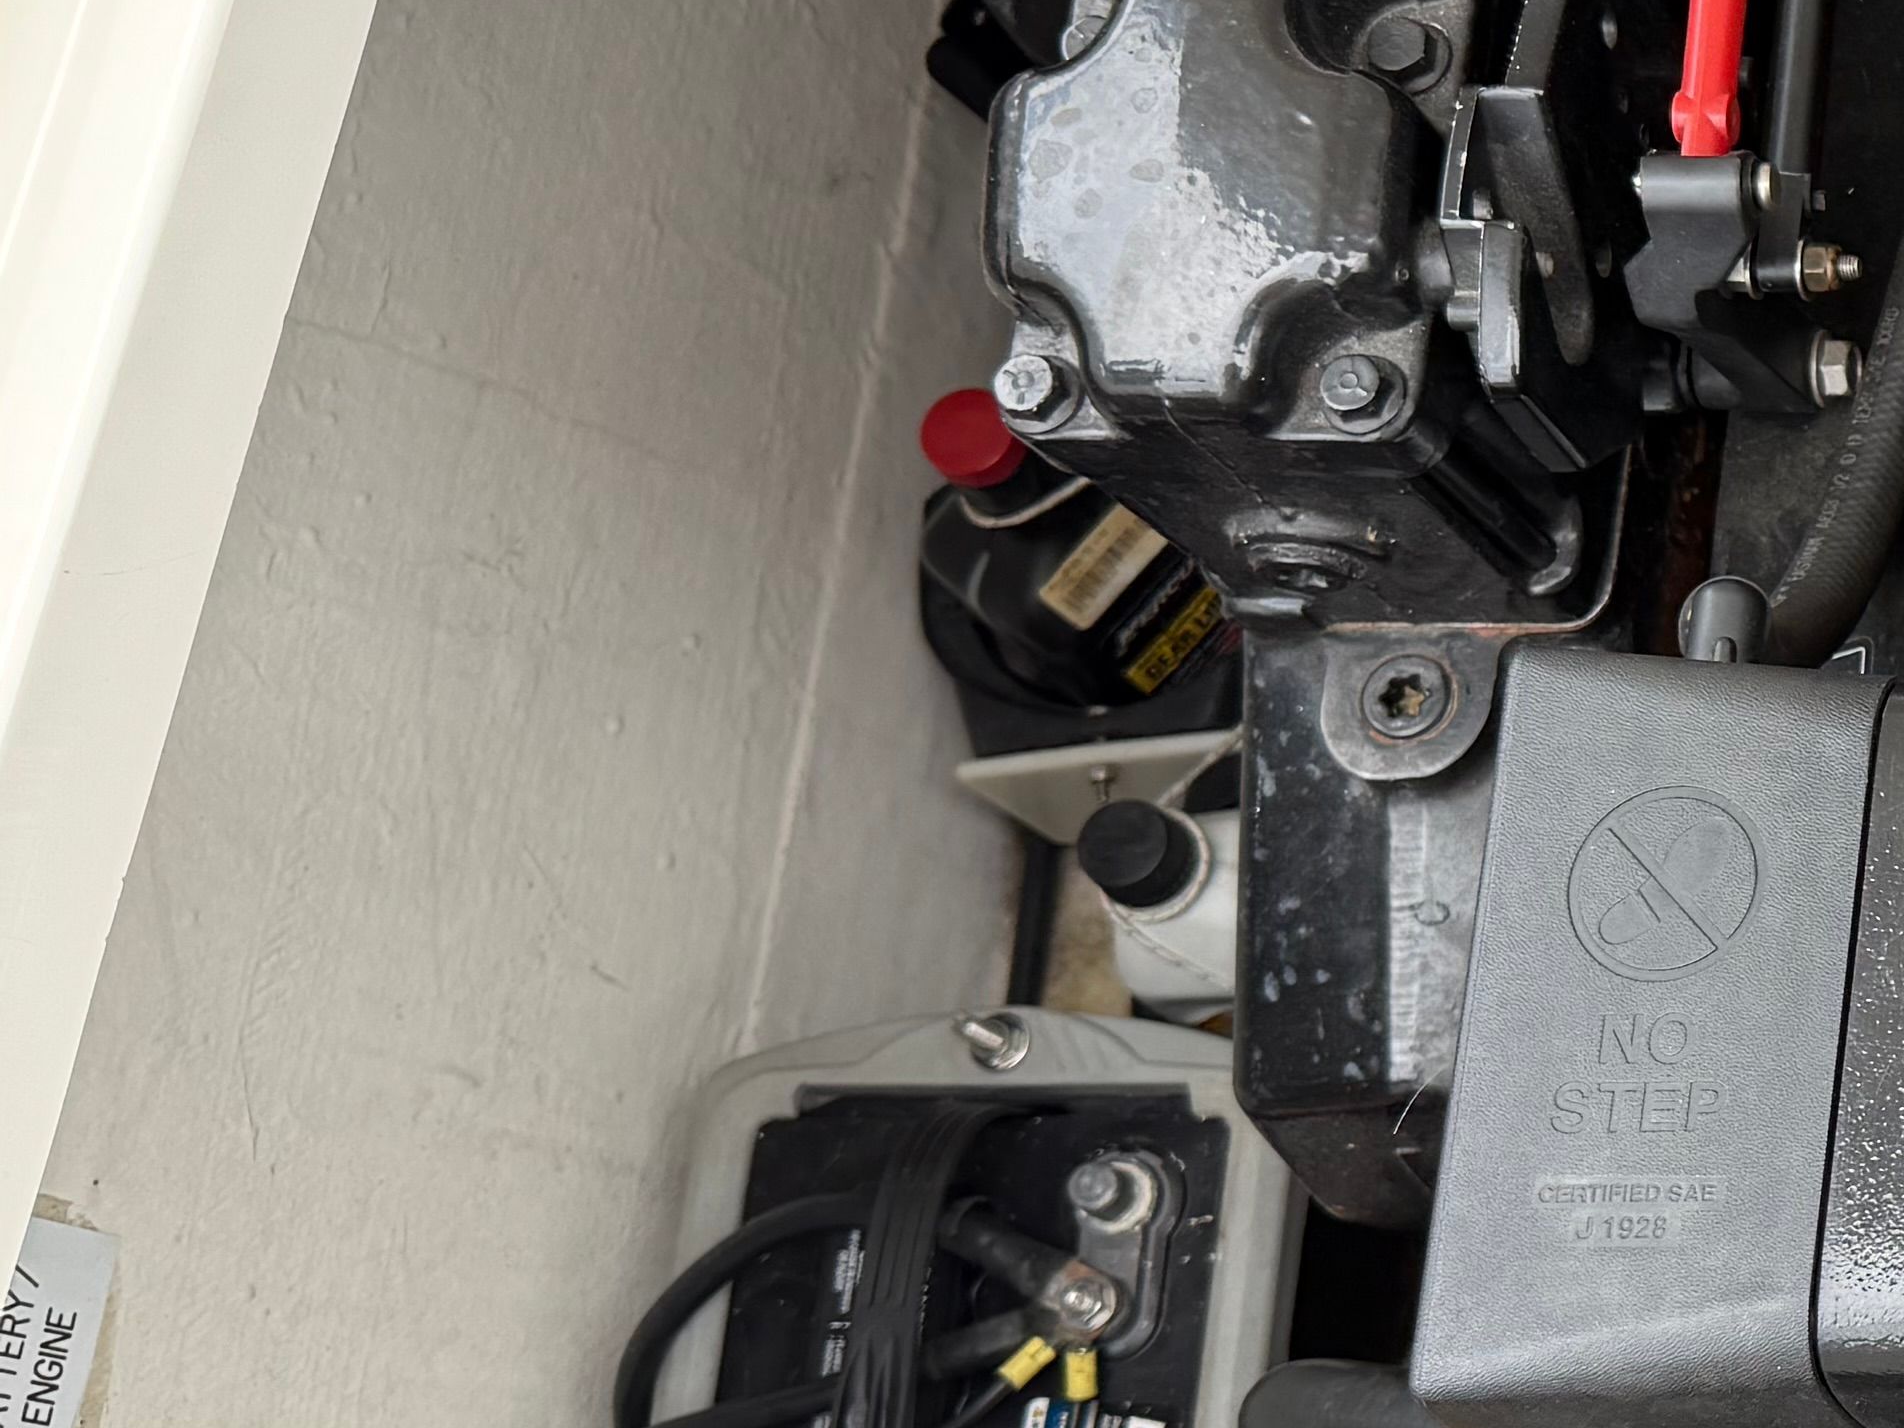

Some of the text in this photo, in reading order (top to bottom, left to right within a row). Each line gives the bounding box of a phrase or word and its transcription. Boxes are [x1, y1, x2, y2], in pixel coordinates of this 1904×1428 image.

[1596, 1012, 1696, 1066] NO
[1549, 1080, 1729, 1135] STEP
[1537, 1183, 1718, 1204] CERTIFIED SAE
[20, 1305, 78, 1428] ENGINE
